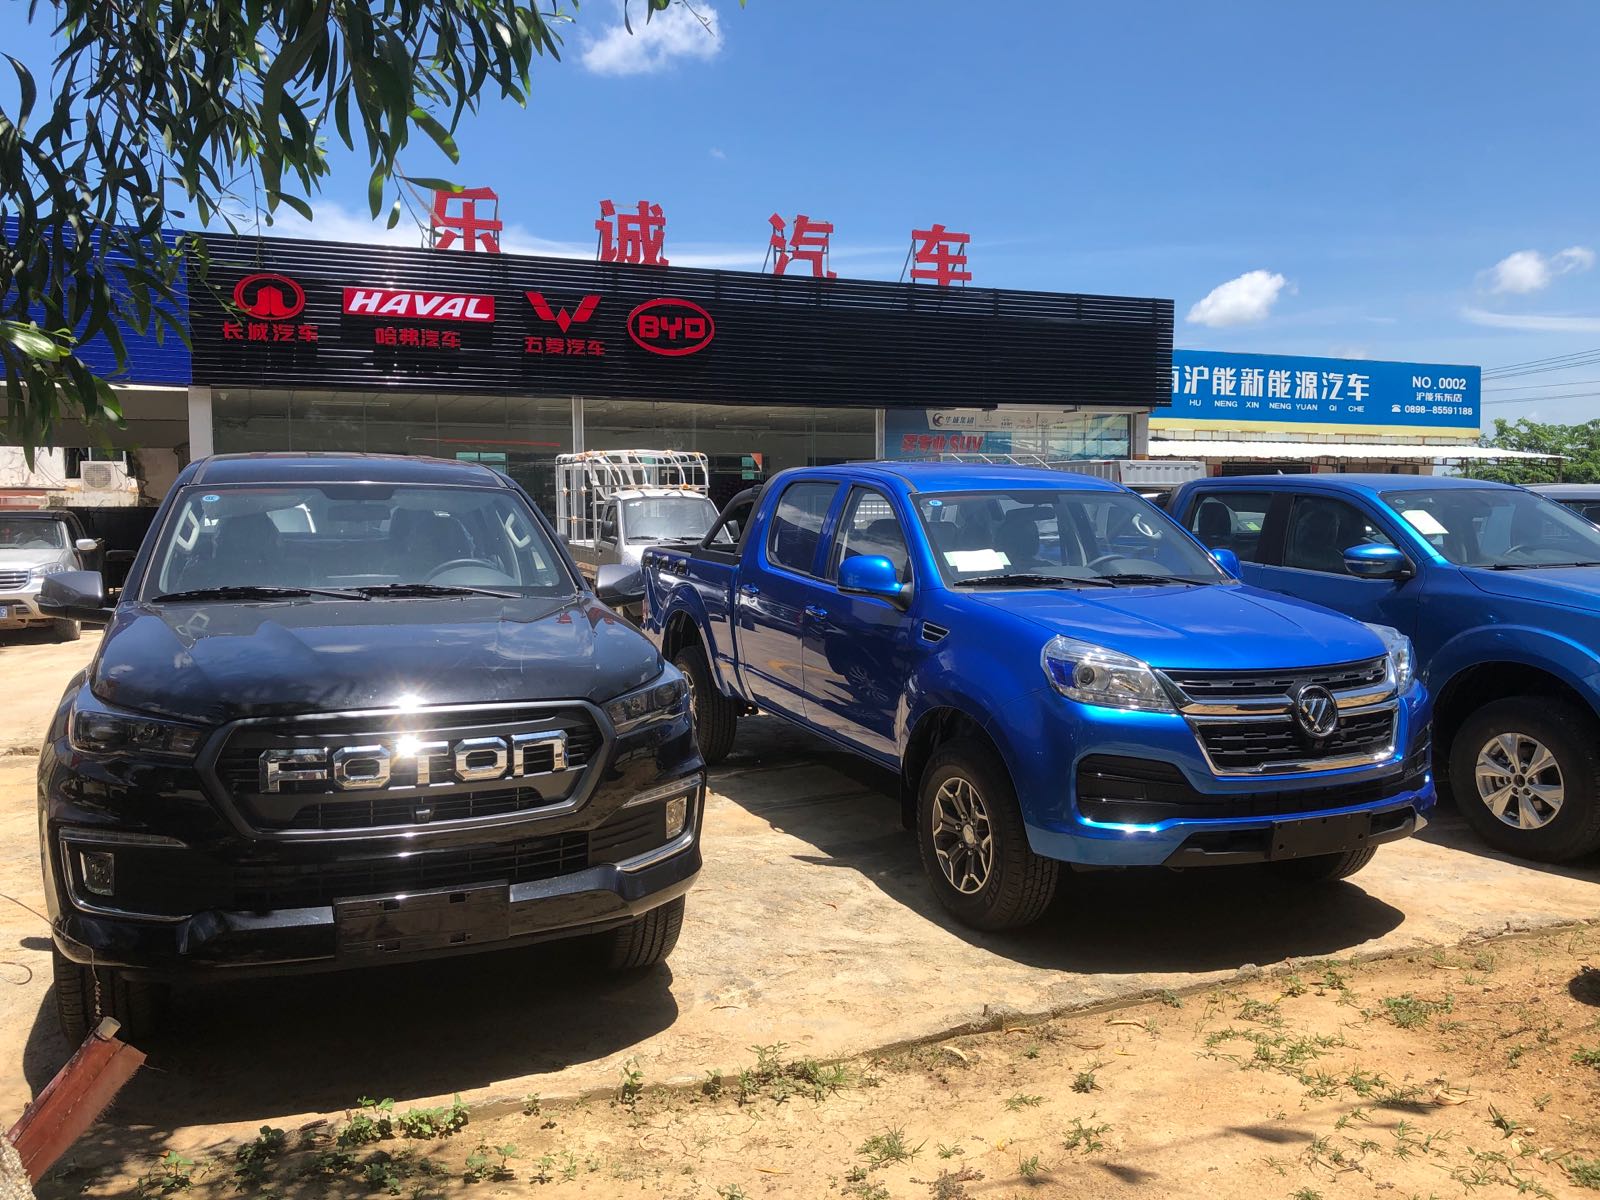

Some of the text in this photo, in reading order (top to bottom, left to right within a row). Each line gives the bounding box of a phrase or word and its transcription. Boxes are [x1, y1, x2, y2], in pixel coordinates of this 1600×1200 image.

[432, 187, 972, 287] 乐诚汽车
[347, 290, 493, 319] HAVAL
[222, 321, 320, 343] 长城汽车
[375, 327, 462, 350] 哈弗汽车
[638, 314, 706, 341] BYD
[524, 336, 606, 357] 五菱汽车
[1172, 365, 1370, 402] 沪能新能源汽车
[1189, 399, 1202, 407] HU
[1214, 400, 1238, 408] NENG
[1245, 401, 1260, 409] XIN
[1269, 402, 1292, 410] NENG
[1295, 403, 1318, 411] YUAN
[1348, 405, 1365, 413] CHE
[259, 730, 569, 794] FOTON
